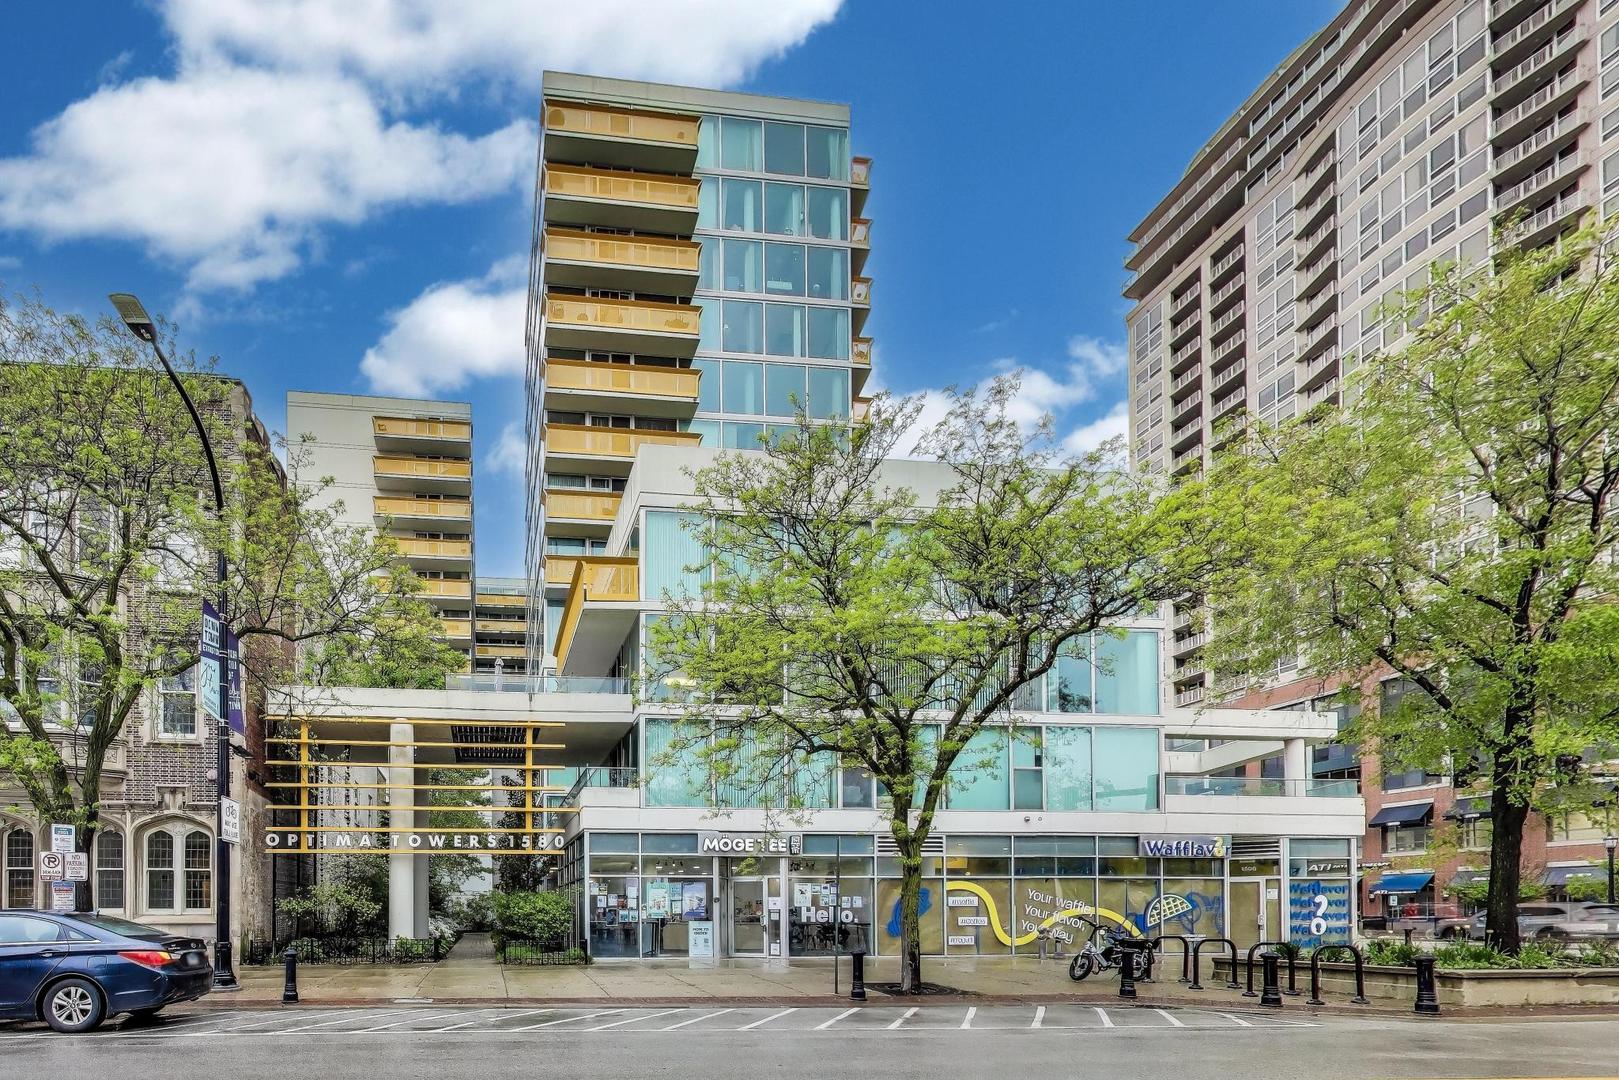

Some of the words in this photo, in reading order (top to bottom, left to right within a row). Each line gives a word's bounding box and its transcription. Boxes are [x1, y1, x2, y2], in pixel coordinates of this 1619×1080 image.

[265, 833, 372, 847] OPTIMA
[391, 833, 497, 848] TOWERS
[508, 835, 566, 848] 1580
[703, 834, 754, 852] MÖGE
[1028, 888, 1053, 904] Your
[801, 906, 859, 923] Hello.
[1025, 904, 1050, 919] Your
